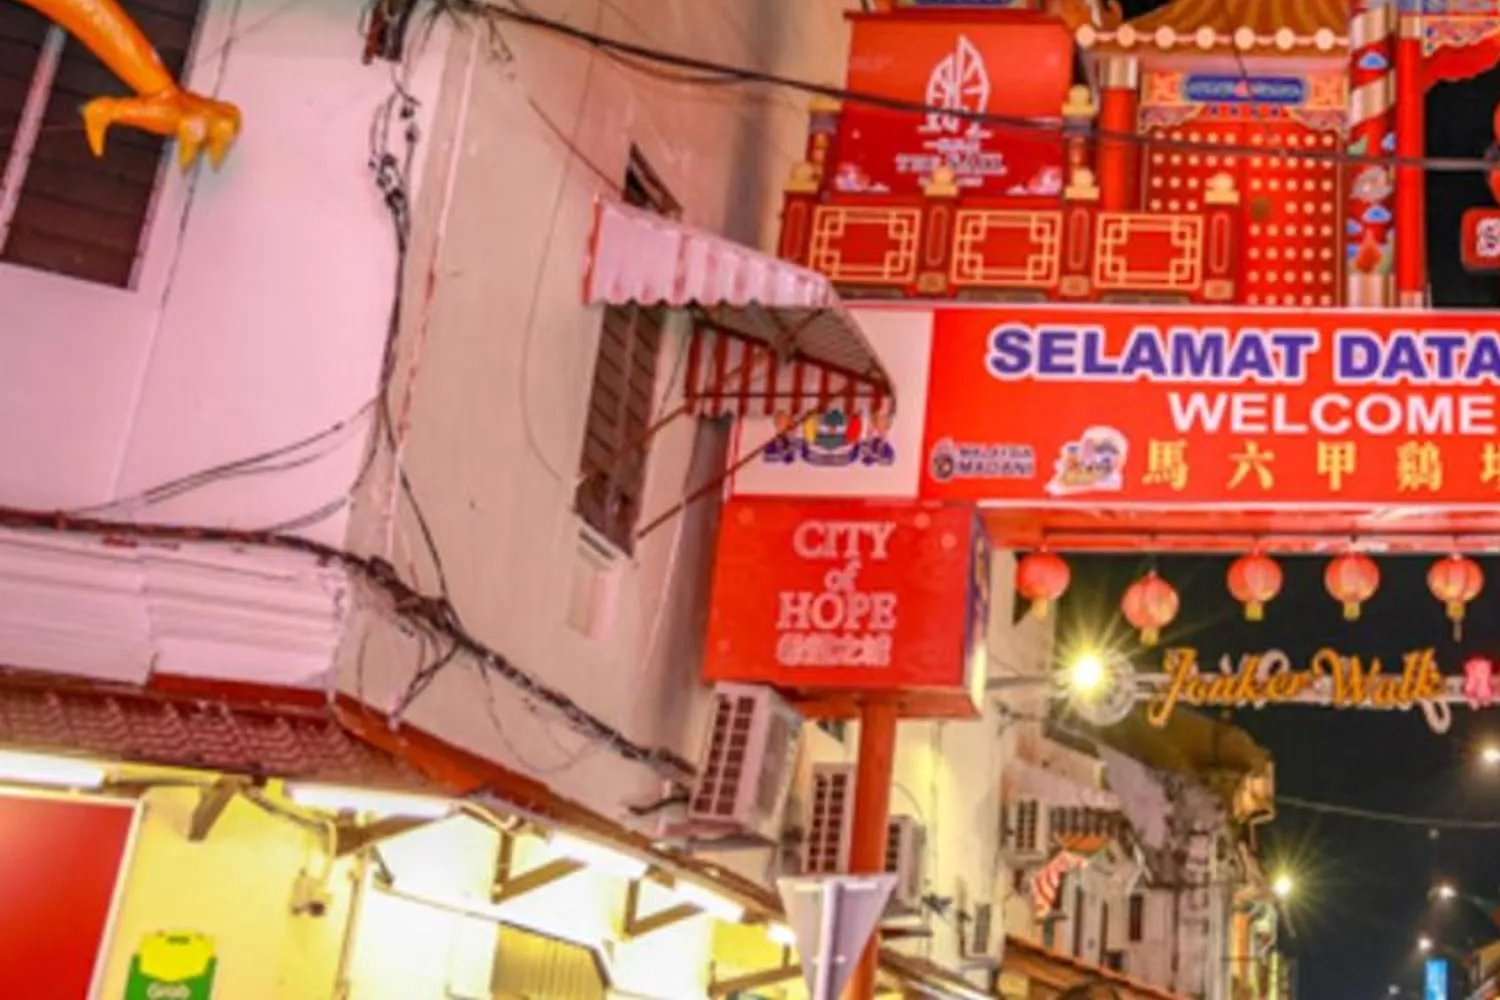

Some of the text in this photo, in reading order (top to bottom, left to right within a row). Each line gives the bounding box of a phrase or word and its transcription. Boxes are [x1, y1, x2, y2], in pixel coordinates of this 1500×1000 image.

[985, 327, 1319, 382] SELAMAT
[1168, 392, 1497, 436] WELCOME
[792, 519, 898, 560] CITY
[824, 557, 863, 594] of
[776, 590, 898, 631] HOPE
[1149, 648, 1451, 728] Jonker Walk
